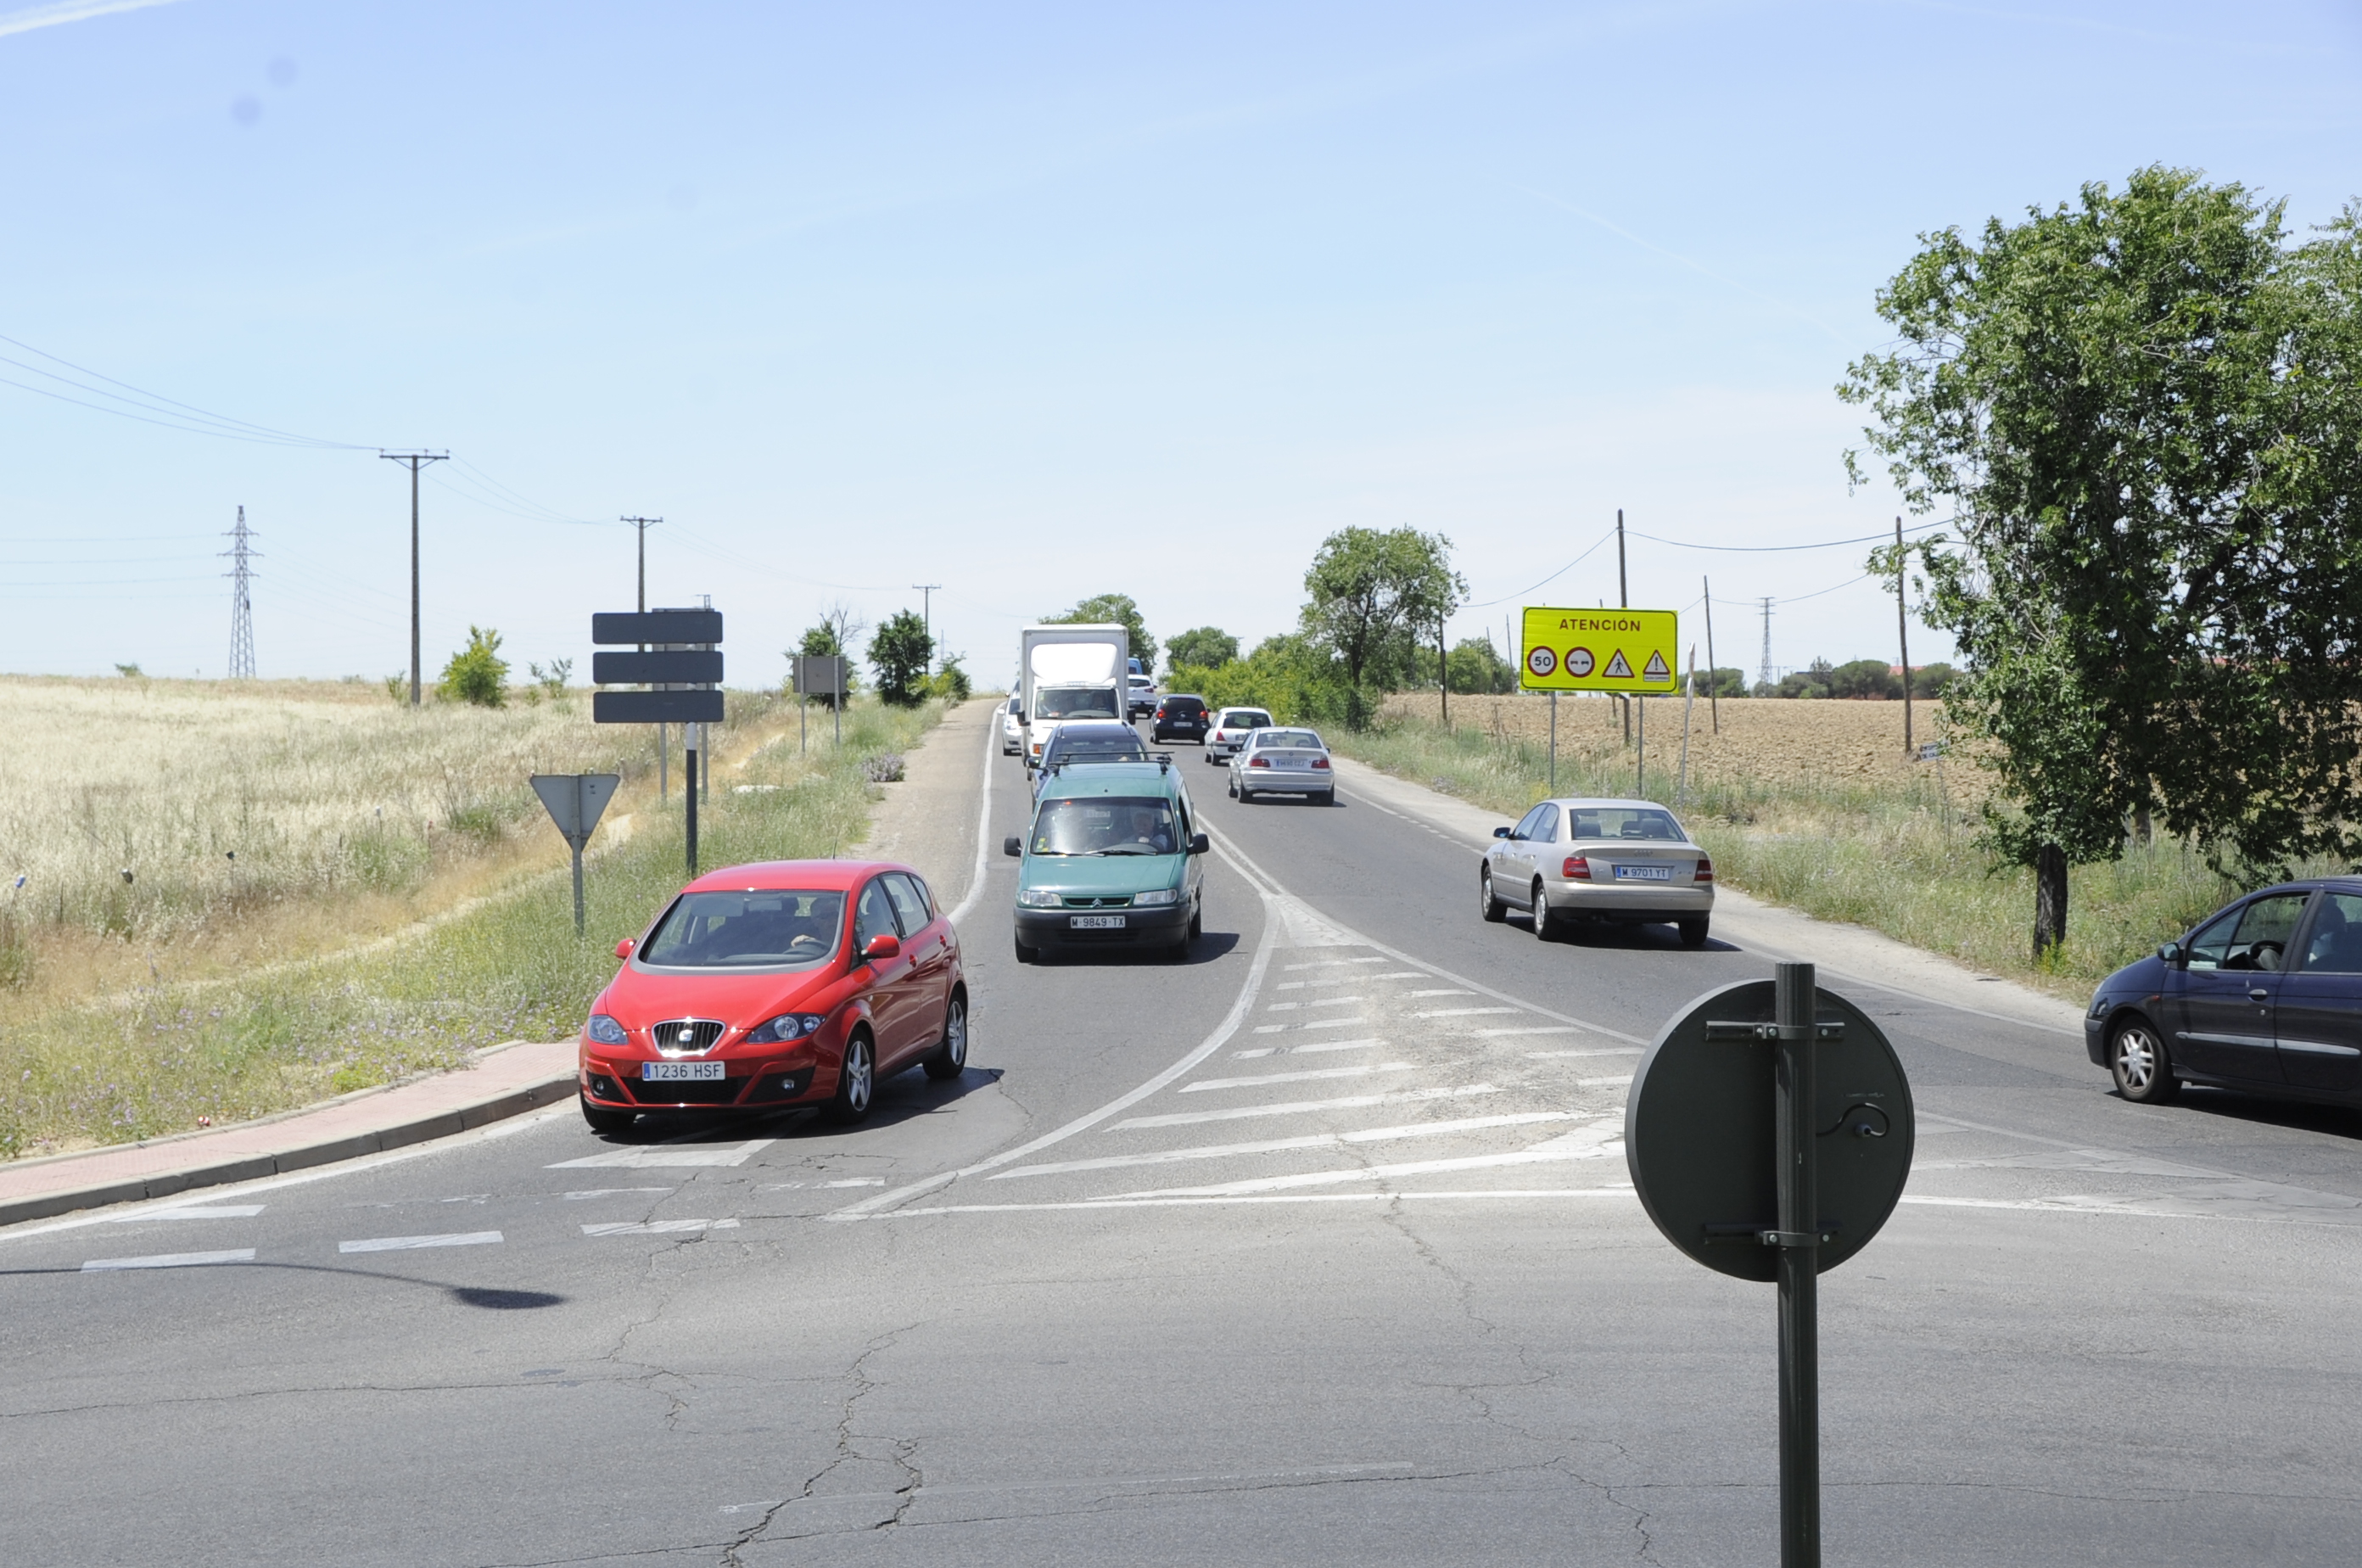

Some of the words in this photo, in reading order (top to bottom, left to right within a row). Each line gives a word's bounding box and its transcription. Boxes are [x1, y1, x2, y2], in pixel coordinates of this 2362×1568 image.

[1559, 618, 1641, 632] ATENCIÓN
[1534, 656, 1552, 667] 50
[654, 1064, 688, 1078] 1236
[694, 1064, 721, 1078] HSF
